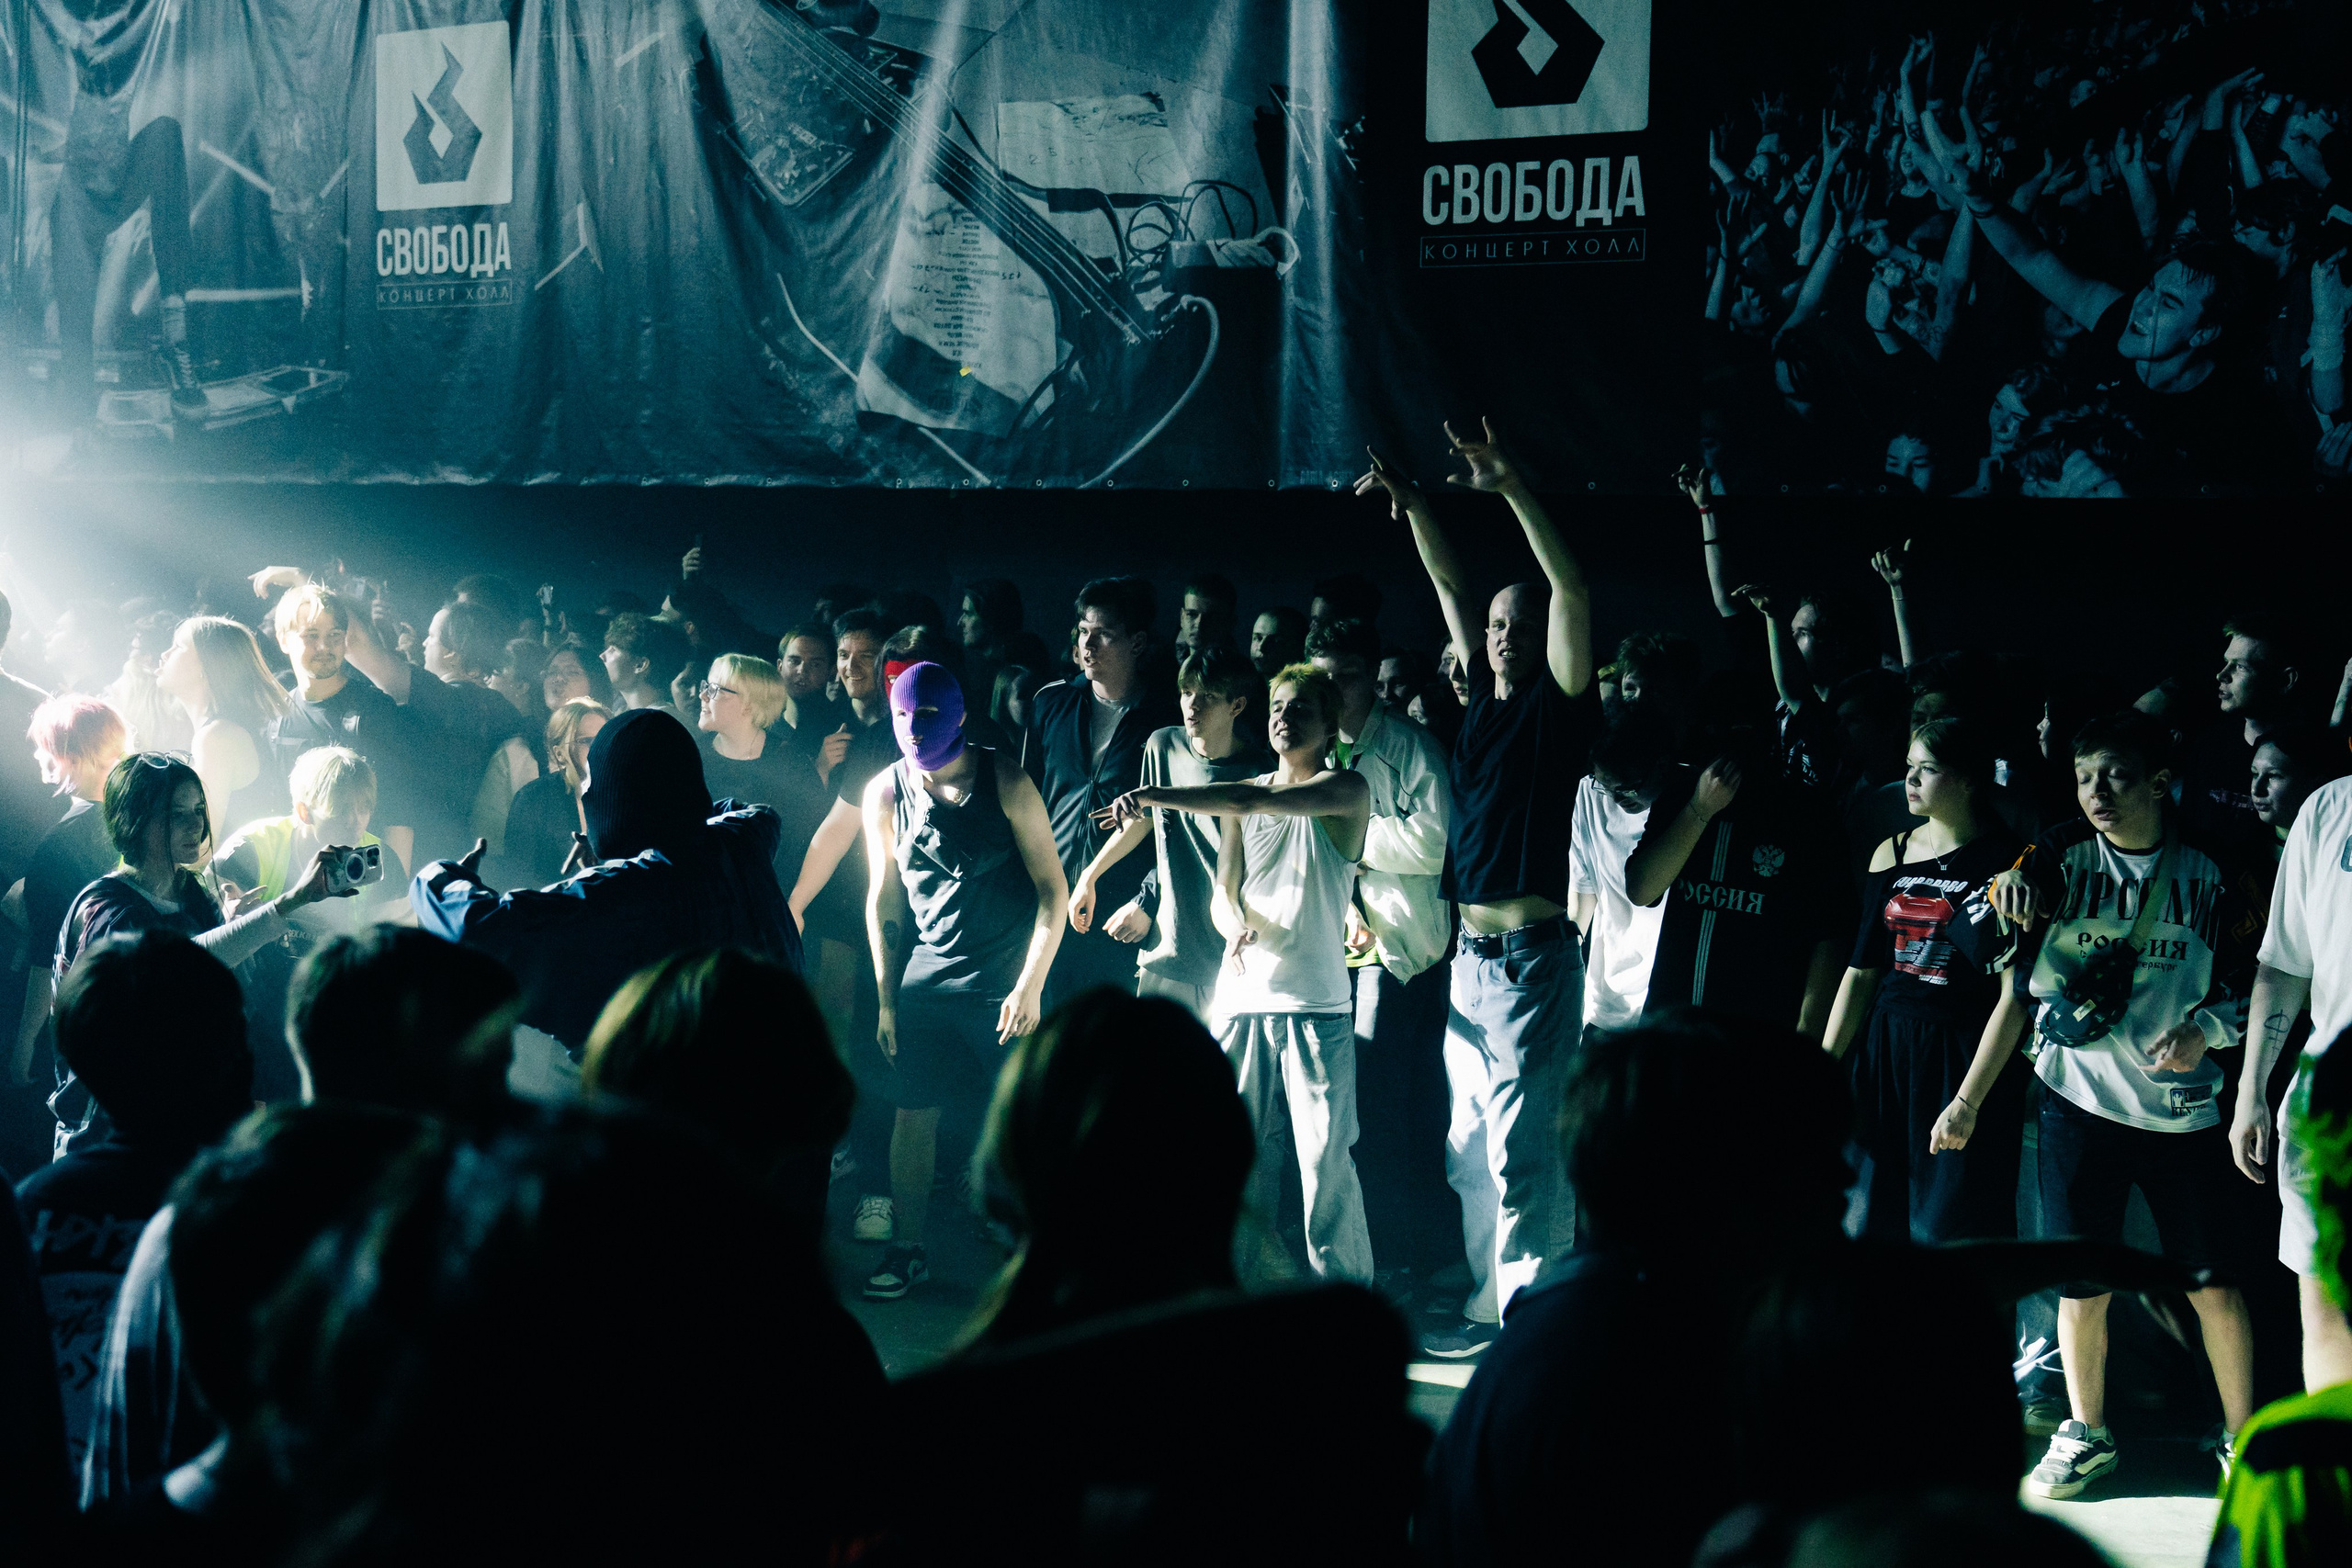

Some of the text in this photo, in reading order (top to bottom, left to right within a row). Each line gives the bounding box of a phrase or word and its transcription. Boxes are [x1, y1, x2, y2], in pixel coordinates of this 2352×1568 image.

[1422, 155, 1645, 227] СВОБОДА
[376, 222, 511, 278] СВОБОДА
[1425, 237, 1640, 260] КОНЦЕРТ ХОЛЛ
[377, 285, 510, 303] КОНЦЕРТ ХОЛЛ
[2076, 932, 2188, 961] РОСИЯ
